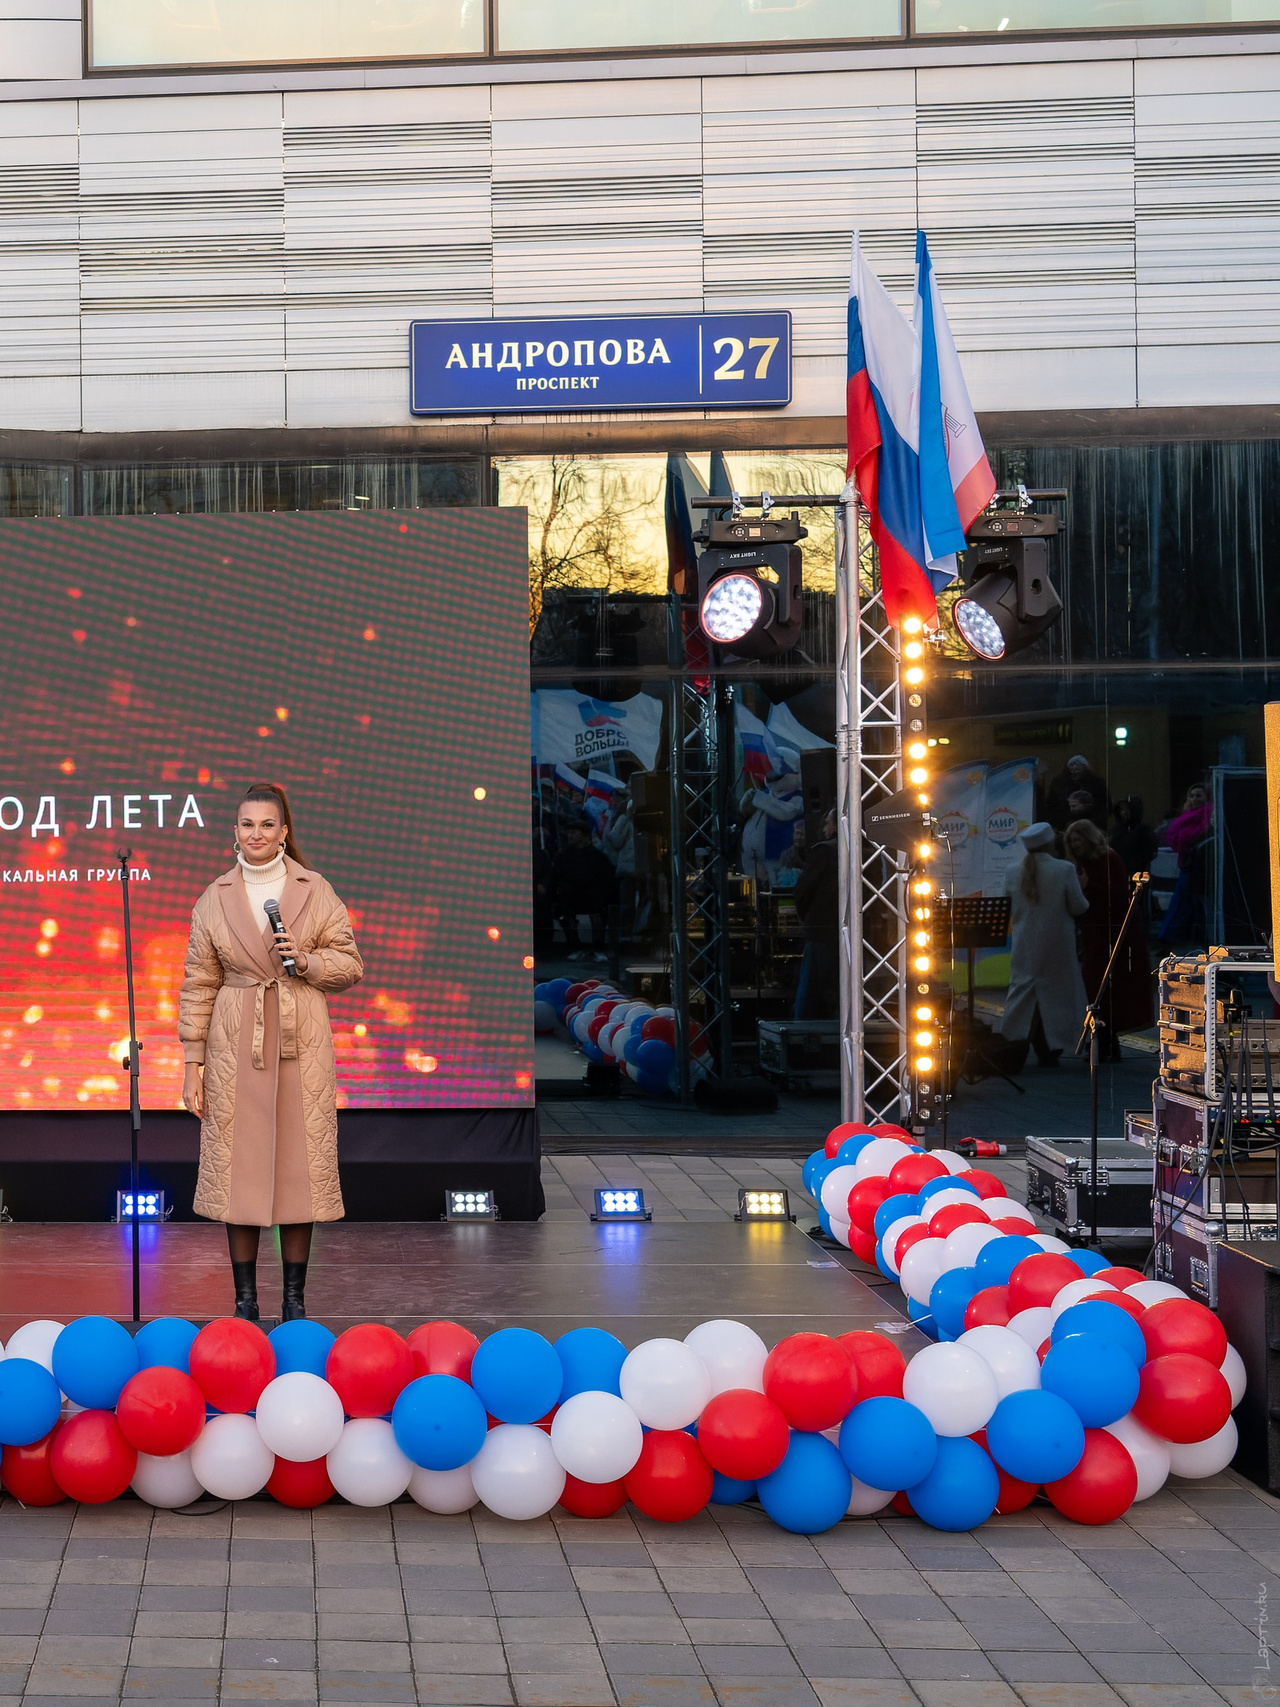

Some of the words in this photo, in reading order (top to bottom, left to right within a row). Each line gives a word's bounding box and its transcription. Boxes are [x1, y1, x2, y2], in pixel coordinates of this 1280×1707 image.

[445, 337, 671, 372] АНДРОПОВА
[713, 337, 780, 380] 27
[516, 376, 600, 391] ПРОСПЕКТ
[86, 793, 205, 829] ЛЕТА
[988, 816, 1016, 829] МИР
